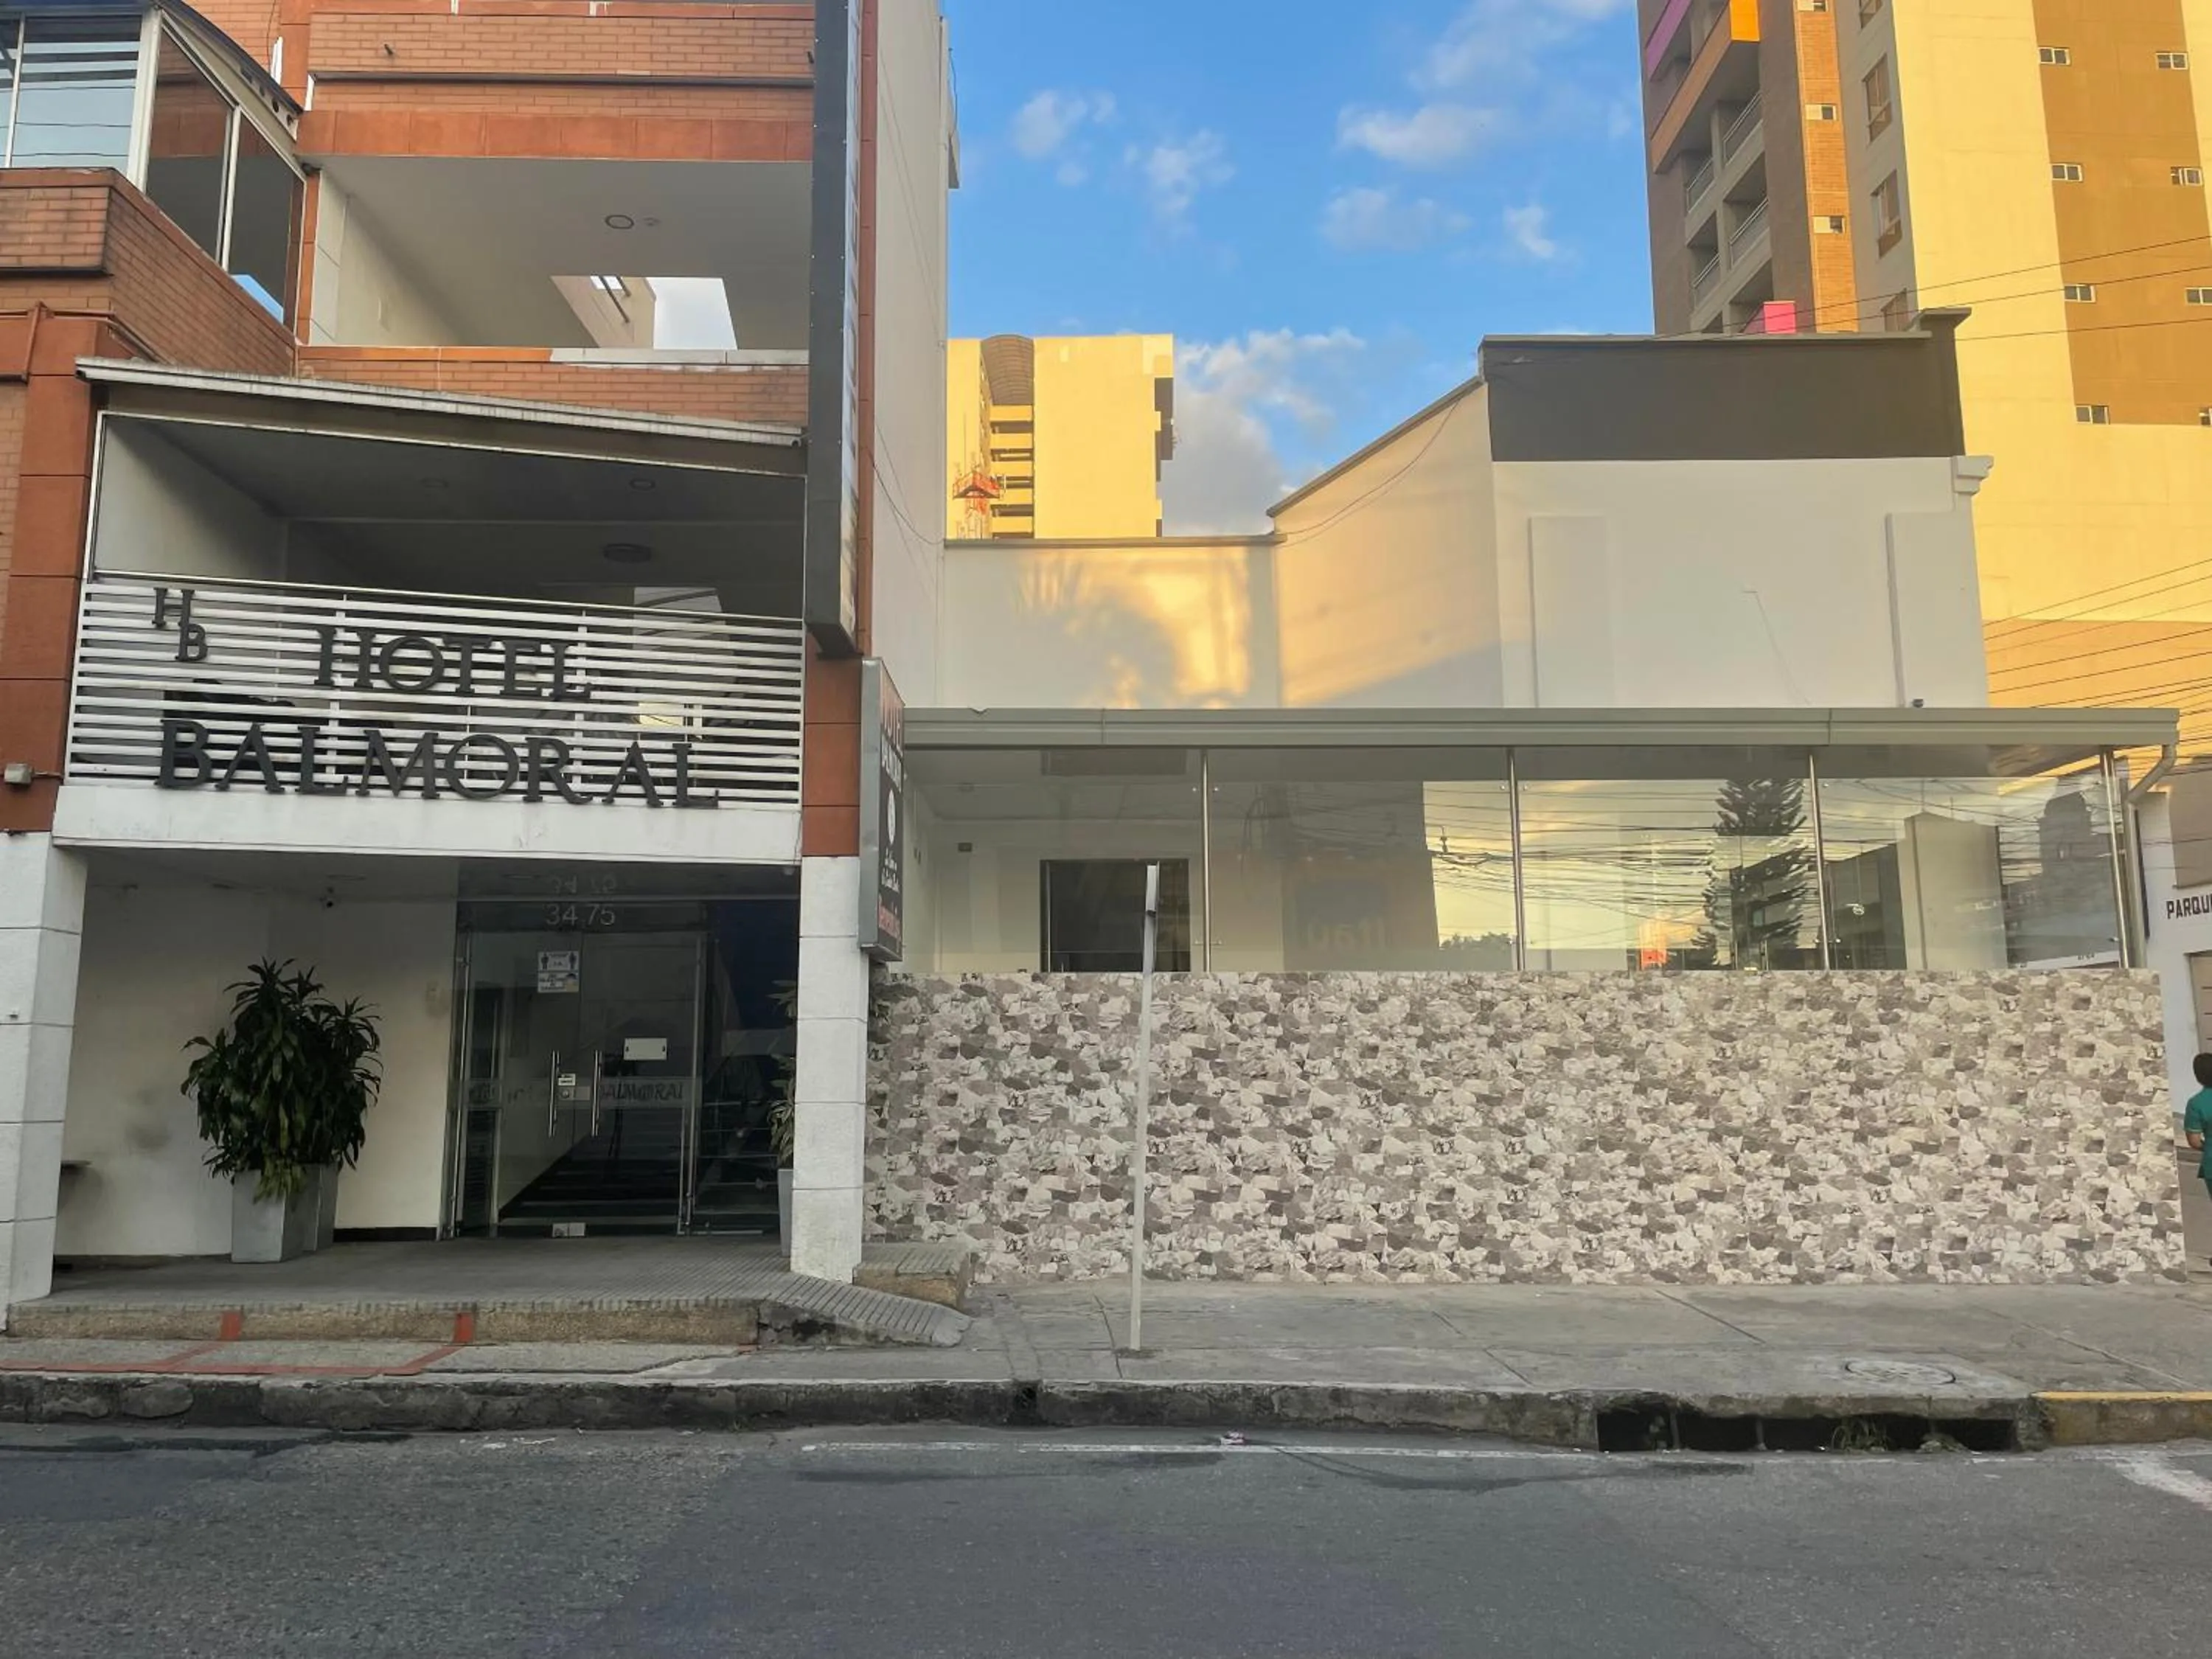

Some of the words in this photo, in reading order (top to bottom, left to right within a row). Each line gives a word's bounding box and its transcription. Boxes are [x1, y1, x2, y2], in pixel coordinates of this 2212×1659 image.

[314, 627, 592, 701] HOTEL
[154, 719, 719, 807] BALMORAL
[2166, 893, 2212, 920] PARQU
